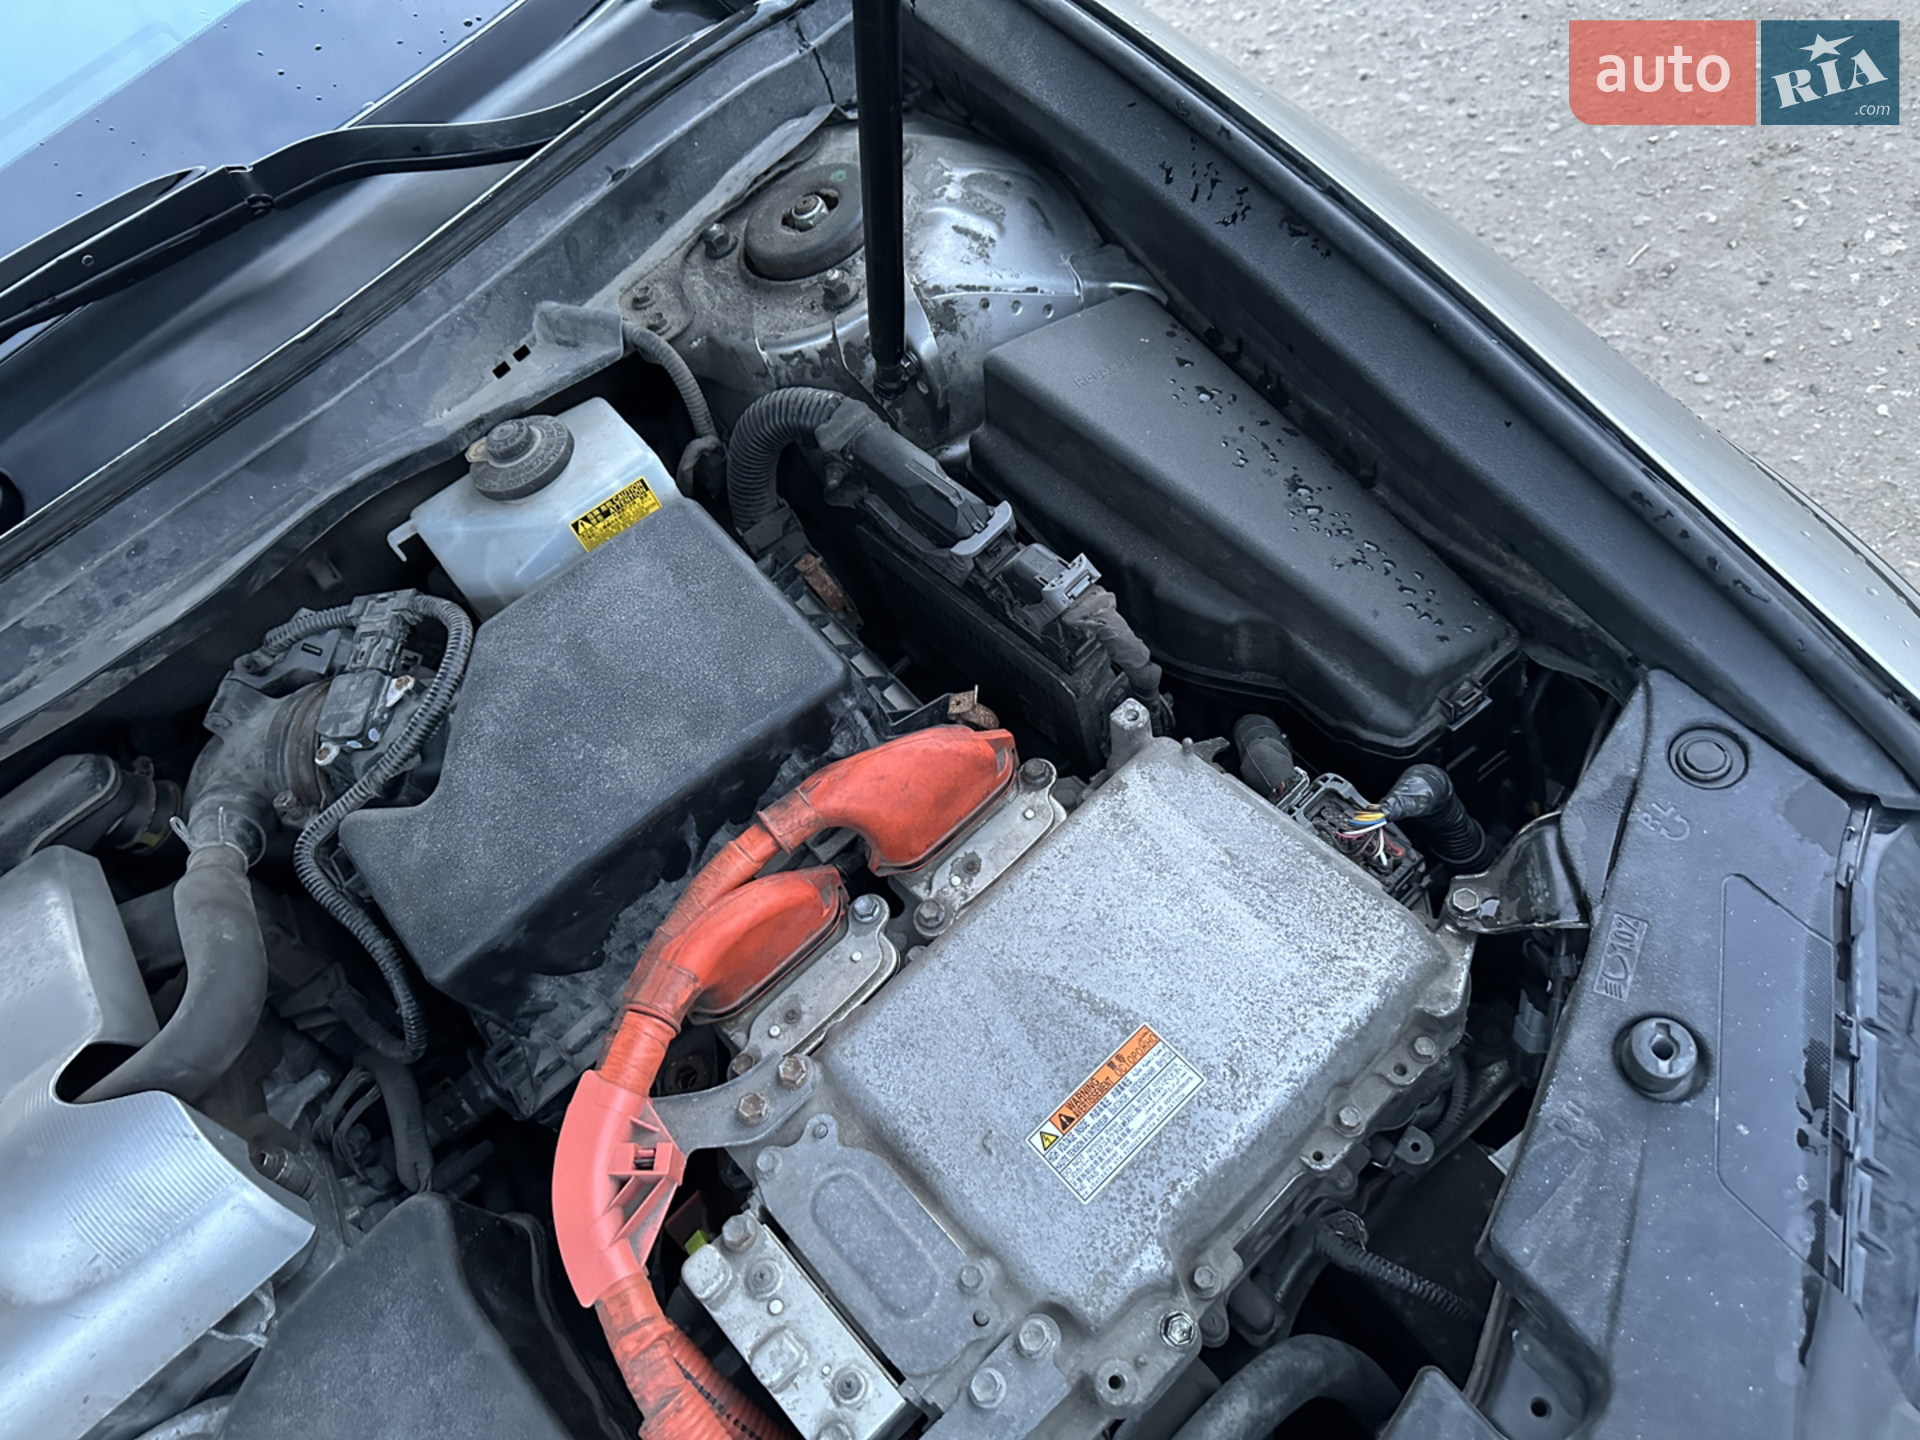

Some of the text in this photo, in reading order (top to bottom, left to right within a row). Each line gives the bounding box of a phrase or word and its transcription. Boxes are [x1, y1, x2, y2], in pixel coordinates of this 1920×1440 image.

[1610, 916, 1640, 952] 1.0%
[1112, 1032, 1158, 1078] ОСТОРОЖНО
[1064, 1076, 1100, 1112] WARNING
[1070, 1075, 1115, 1119] AVERTISSEMENT
